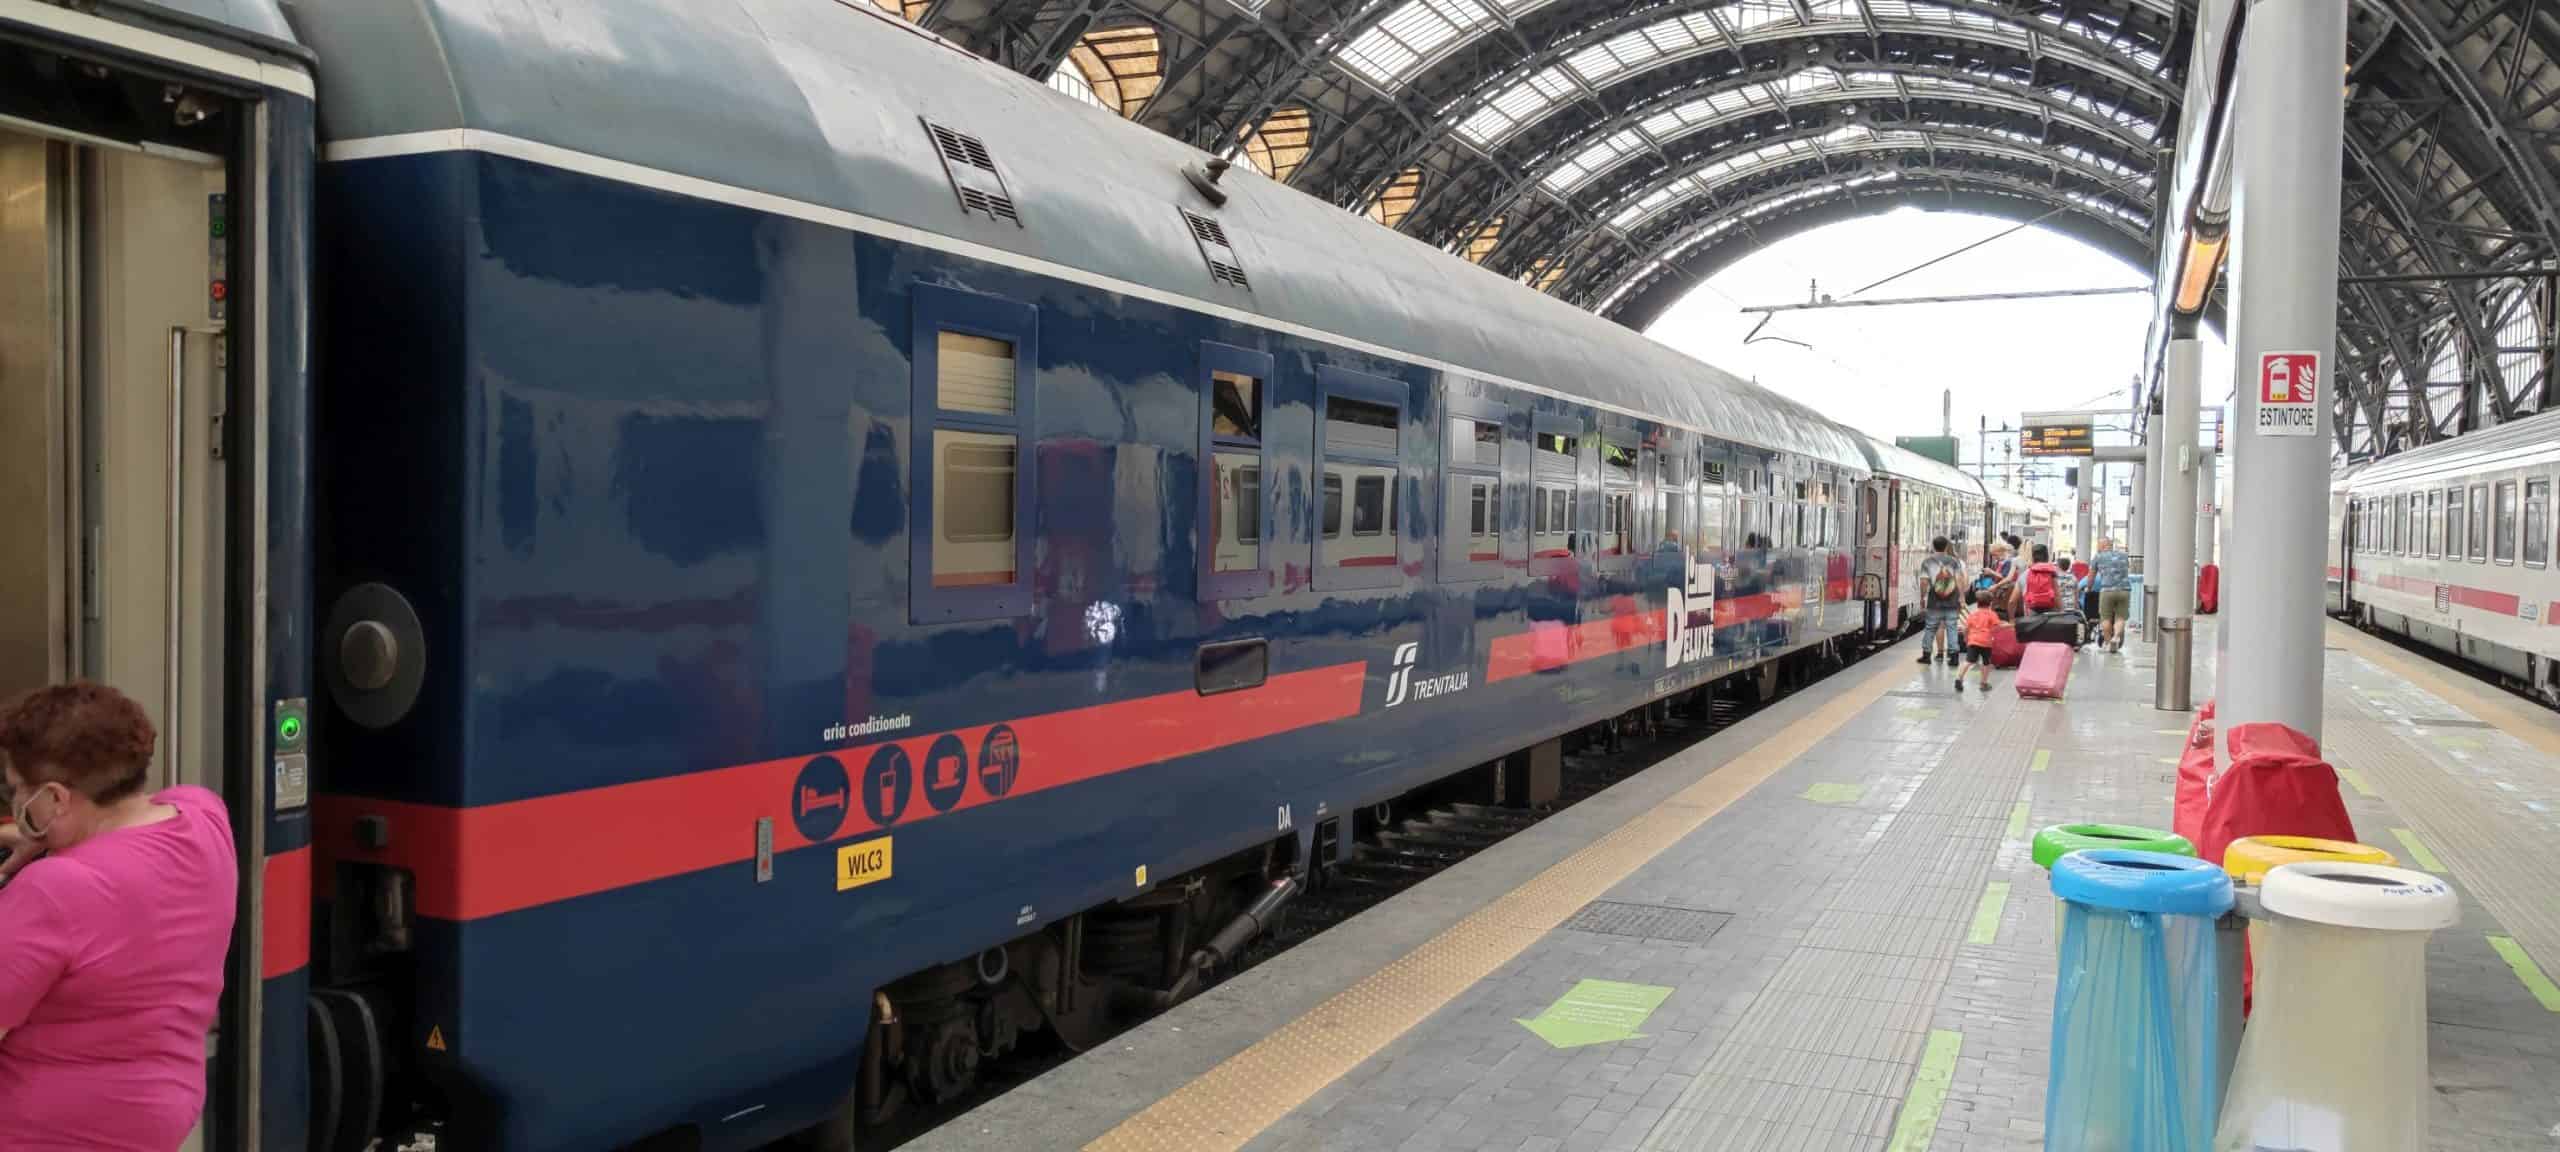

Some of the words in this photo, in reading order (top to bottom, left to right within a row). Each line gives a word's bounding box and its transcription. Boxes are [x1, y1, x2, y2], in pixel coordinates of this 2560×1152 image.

[2260, 407, 2313, 426] ESTINTORE
[1414, 671, 1468, 701] TRENITALIA
[823, 722, 846, 742] aria
[848, 713, 911, 738] condizionata
[1278, 802, 1292, 832] DA
[848, 849, 883, 876] WLC3
